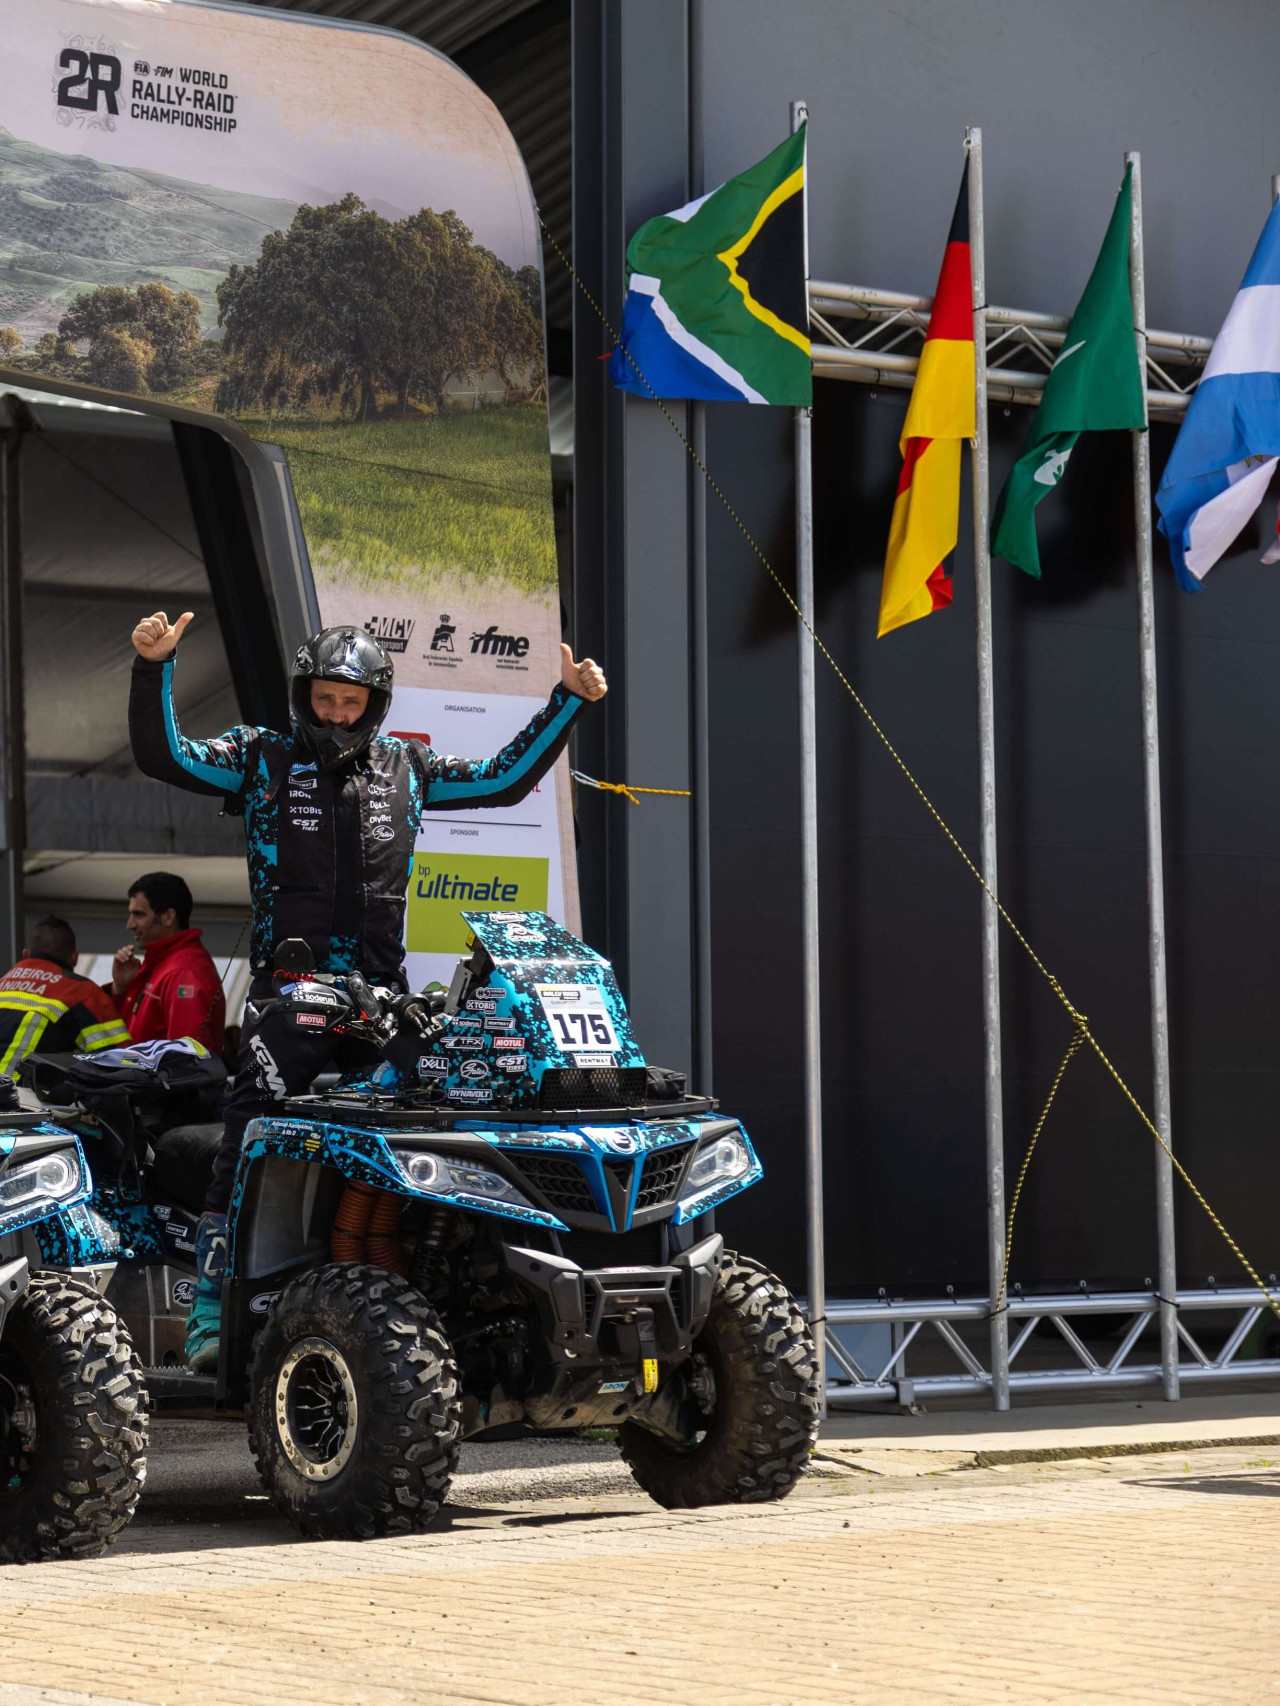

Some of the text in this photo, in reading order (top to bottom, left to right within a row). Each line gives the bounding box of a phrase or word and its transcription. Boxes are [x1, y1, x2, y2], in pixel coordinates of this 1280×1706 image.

[57, 48, 122, 116] 2R
[180, 67, 228, 89] WORLD
[132, 79, 235, 114] RALLY-RAID
[131, 103, 237, 133] CHAMPIONSHIP
[470, 626, 530, 657] rfme
[444, 704, 486, 714] ORGANISATION
[370, 801, 390, 809] DELL
[418, 864, 431, 876] bp
[417, 873, 518, 902] ultimate
[474, 1002, 495, 1010] TOBIS
[299, 1015, 324, 1024] MOTUL
[553, 1014, 612, 1045] 175
[496, 1039, 522, 1047] MOTUL
[249, 1035, 287, 1100] KENN
[421, 1058, 447, 1070] DELL
[497, 1056, 524, 1067] CST
[450, 1089, 490, 1098] DYNAVOLT
